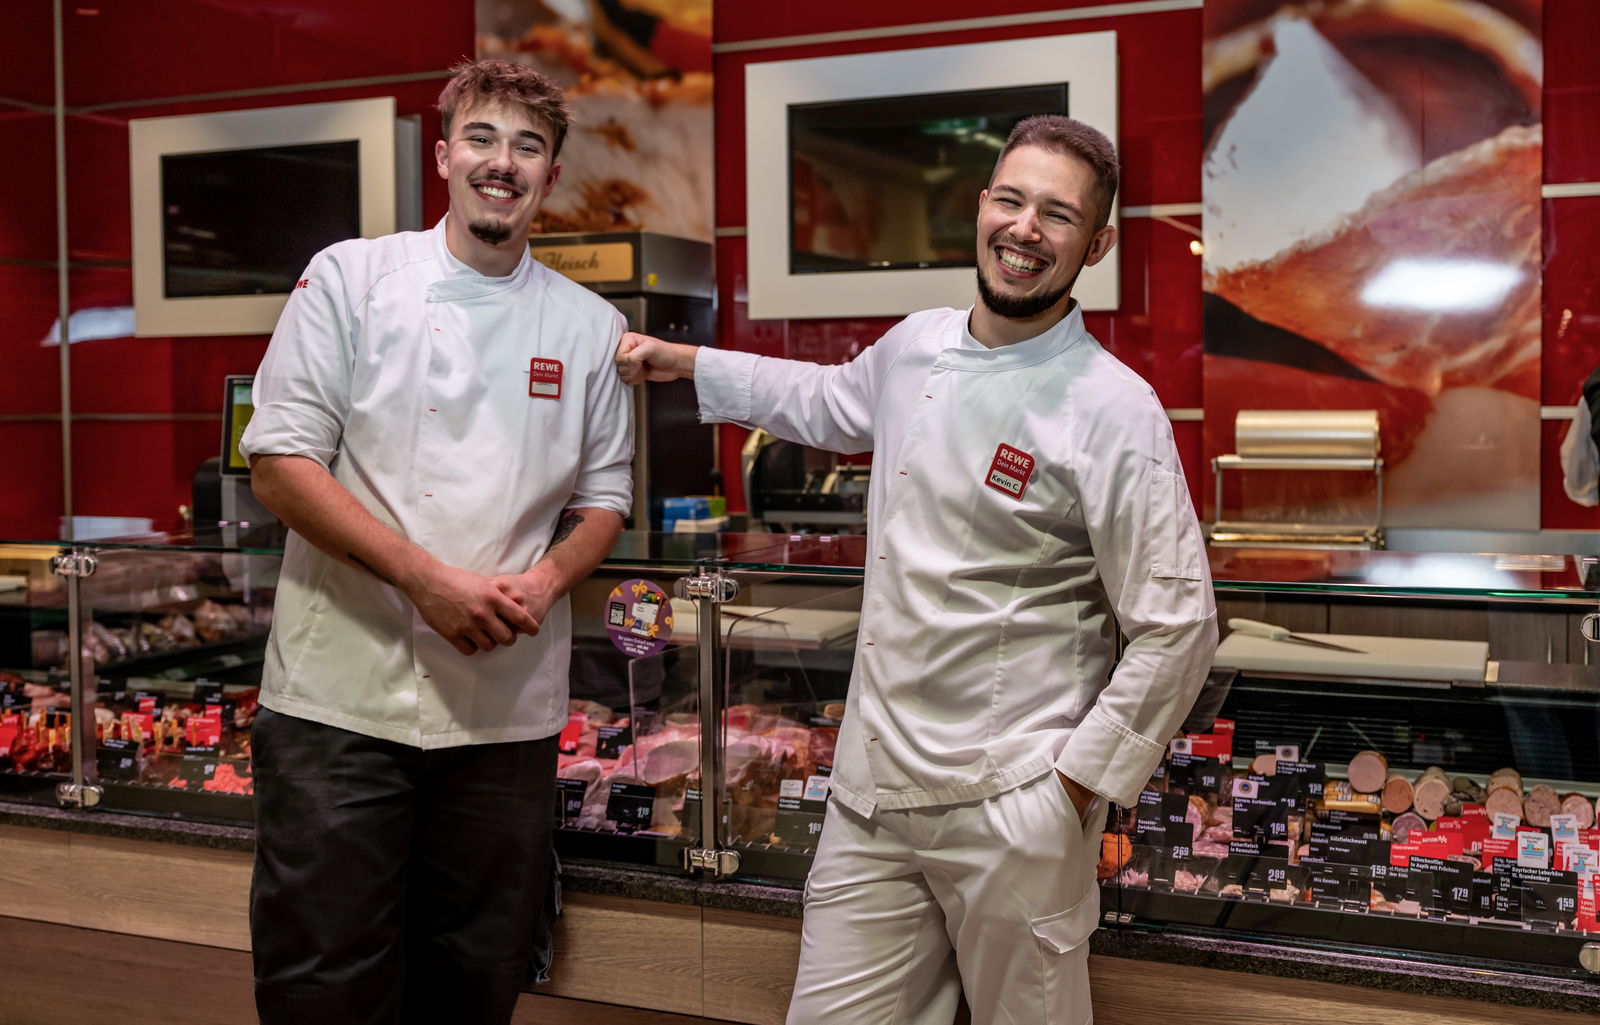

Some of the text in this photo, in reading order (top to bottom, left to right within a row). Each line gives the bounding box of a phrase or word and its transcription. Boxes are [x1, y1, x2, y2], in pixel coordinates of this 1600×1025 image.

[533, 361, 560, 372] REWE
[1000, 448, 1031, 469] REWE
[997, 458, 1026, 476] Dein Markt
[991, 474, 1012, 488] Kevin
